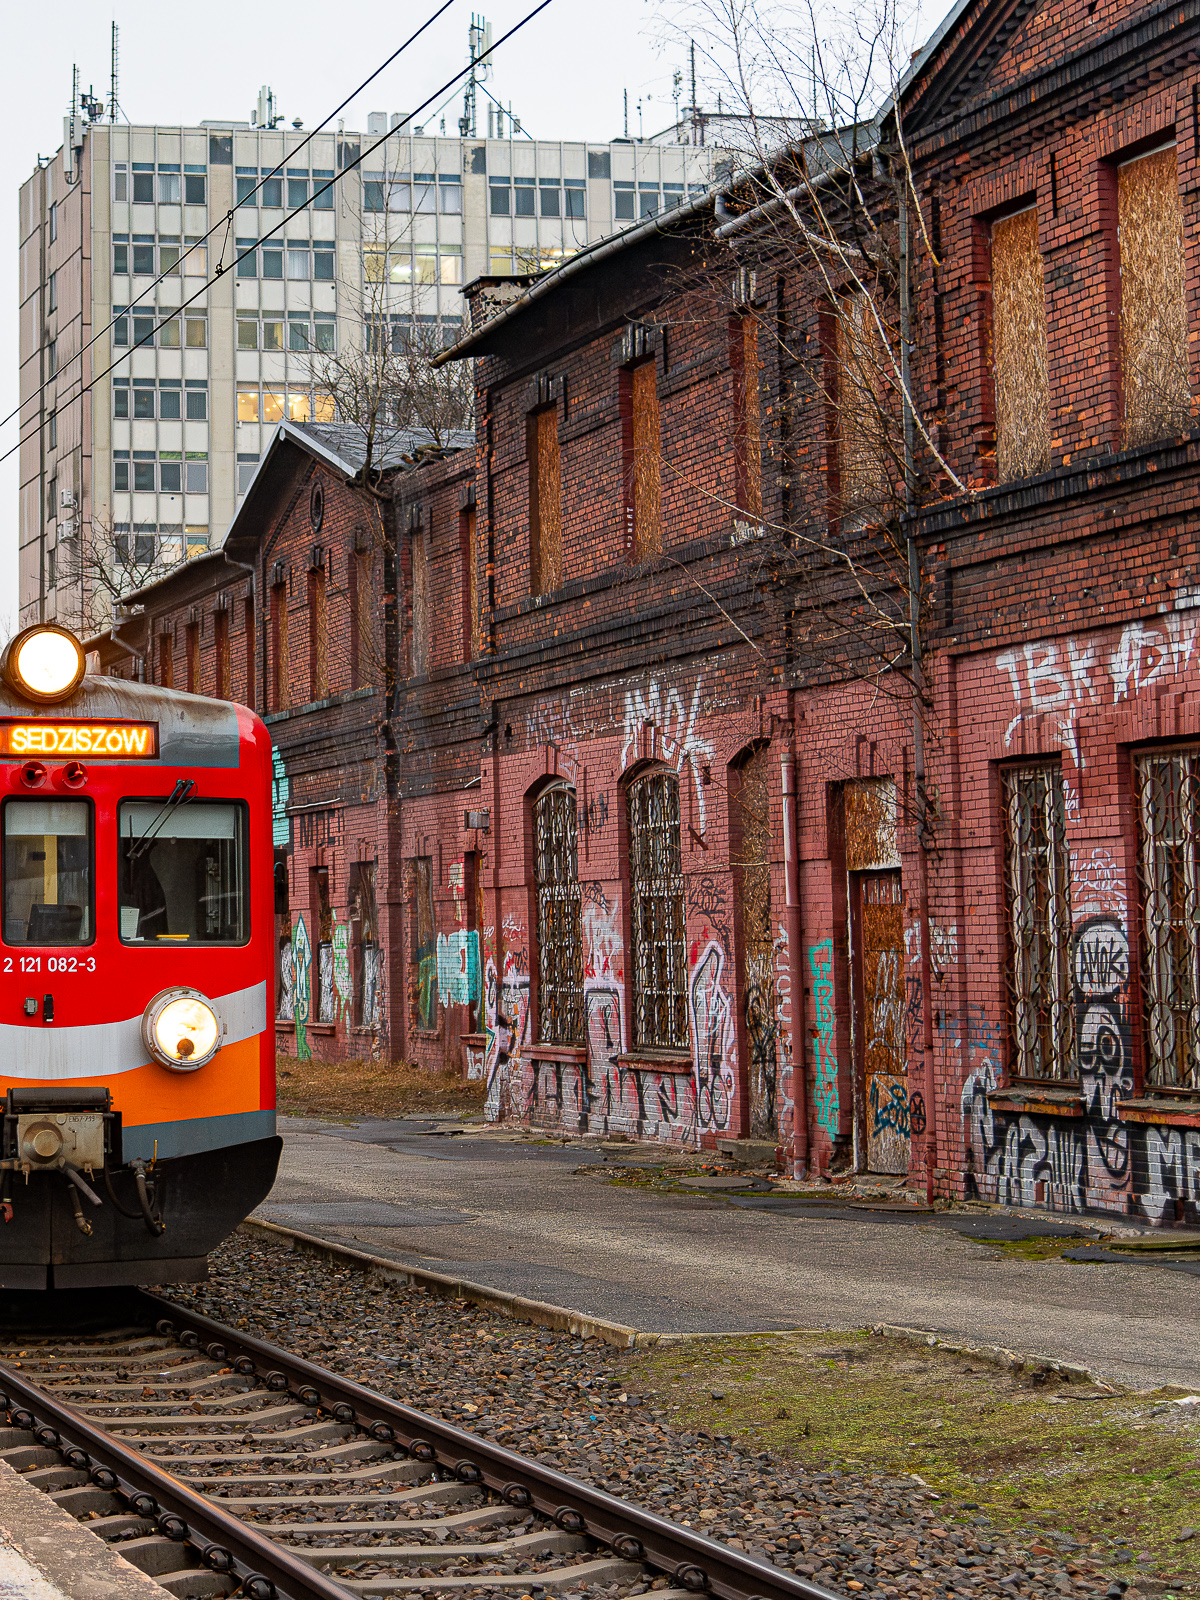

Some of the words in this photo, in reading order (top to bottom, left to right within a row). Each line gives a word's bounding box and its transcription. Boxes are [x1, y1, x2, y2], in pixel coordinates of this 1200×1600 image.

[3, 957, 14, 973] 2
[19, 956, 42, 973] 121
[47, 956, 97, 973] 082-3
